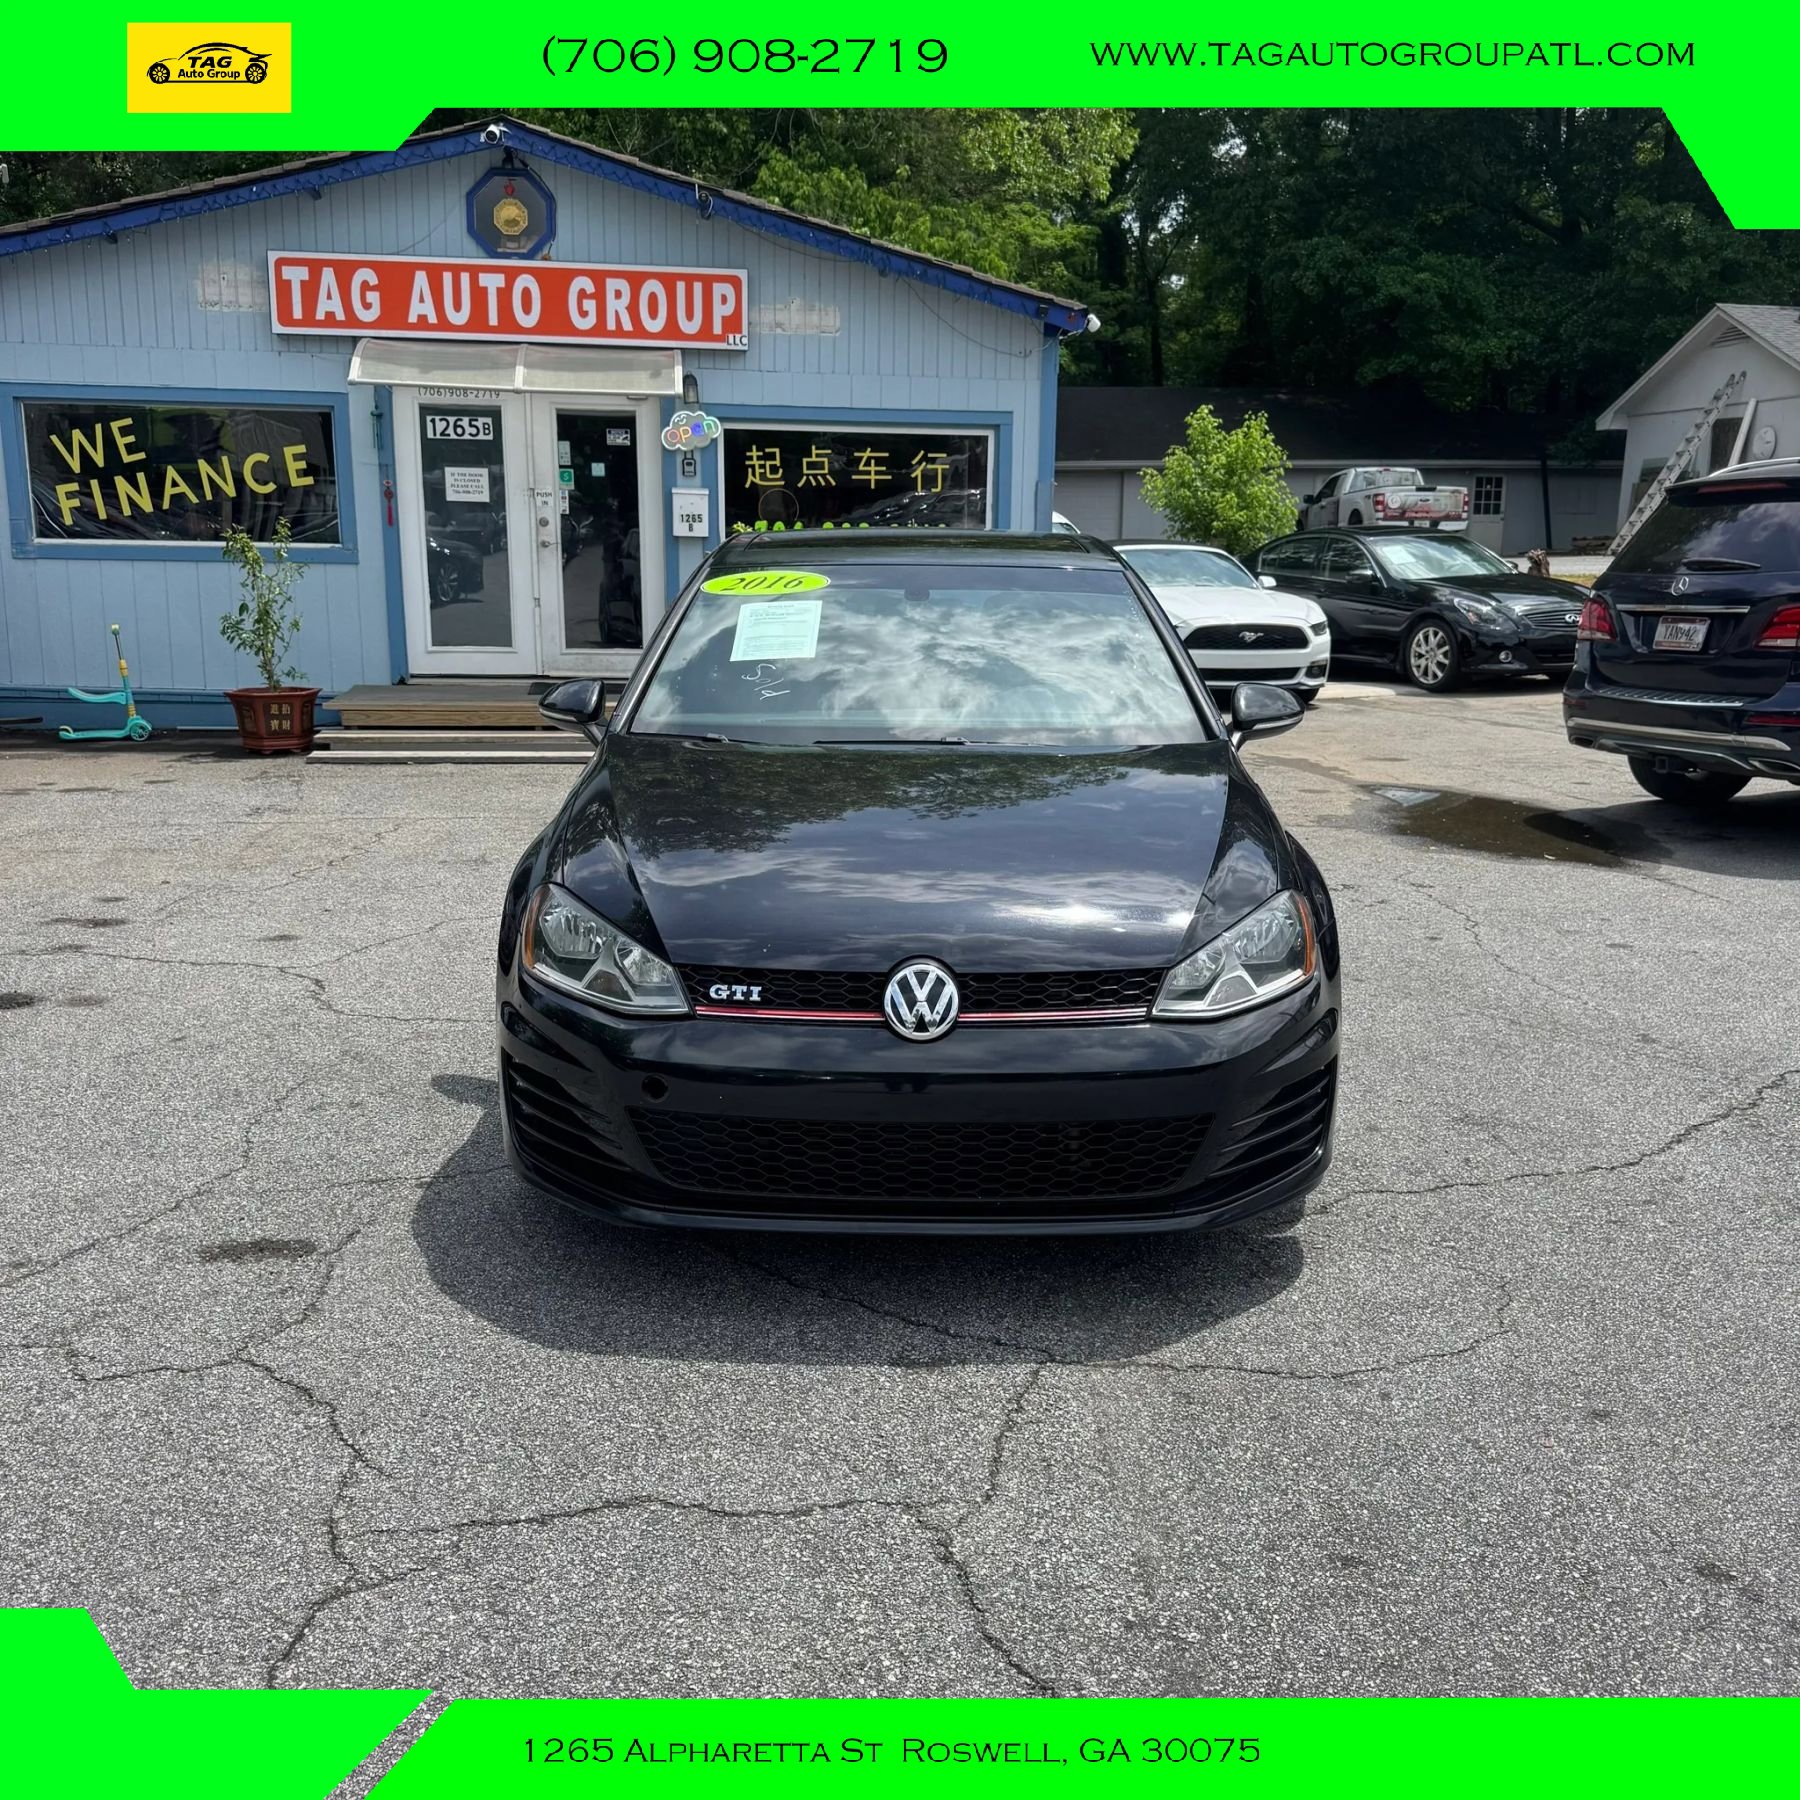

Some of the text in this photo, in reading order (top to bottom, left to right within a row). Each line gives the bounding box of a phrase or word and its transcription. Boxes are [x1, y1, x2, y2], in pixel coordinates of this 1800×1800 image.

[281, 265, 737, 336] TAG AUTO GROUP
[725, 335, 748, 347] LLC
[666, 420, 717, 443] open
[49, 416, 147, 475] WE
[744, 445, 950, 493] 起点车行
[55, 444, 315, 526] FINANCE
[680, 513, 703, 523] 1265
[688, 523, 694, 532] B
[719, 575, 810, 591] 2016
[708, 983, 762, 1001] GTI
